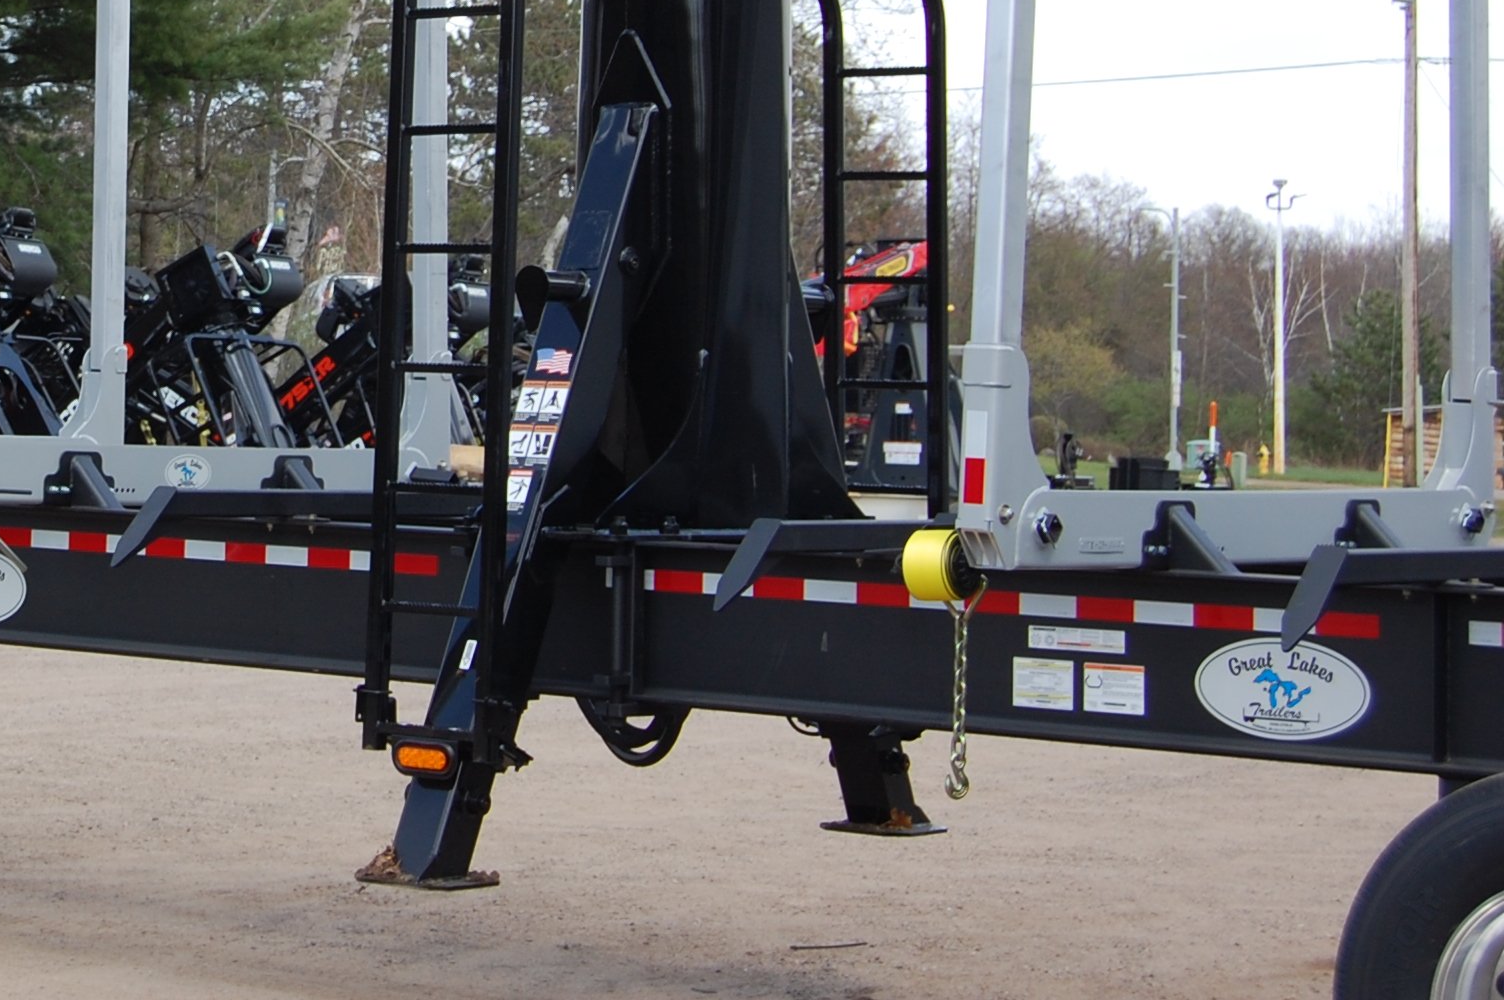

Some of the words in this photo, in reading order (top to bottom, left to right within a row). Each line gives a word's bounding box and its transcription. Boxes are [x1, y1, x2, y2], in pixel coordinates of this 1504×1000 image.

[1228, 651, 1274, 677] Great
[1287, 651, 1335, 684] Lakes
[1249, 702, 1303, 720] Trailers
